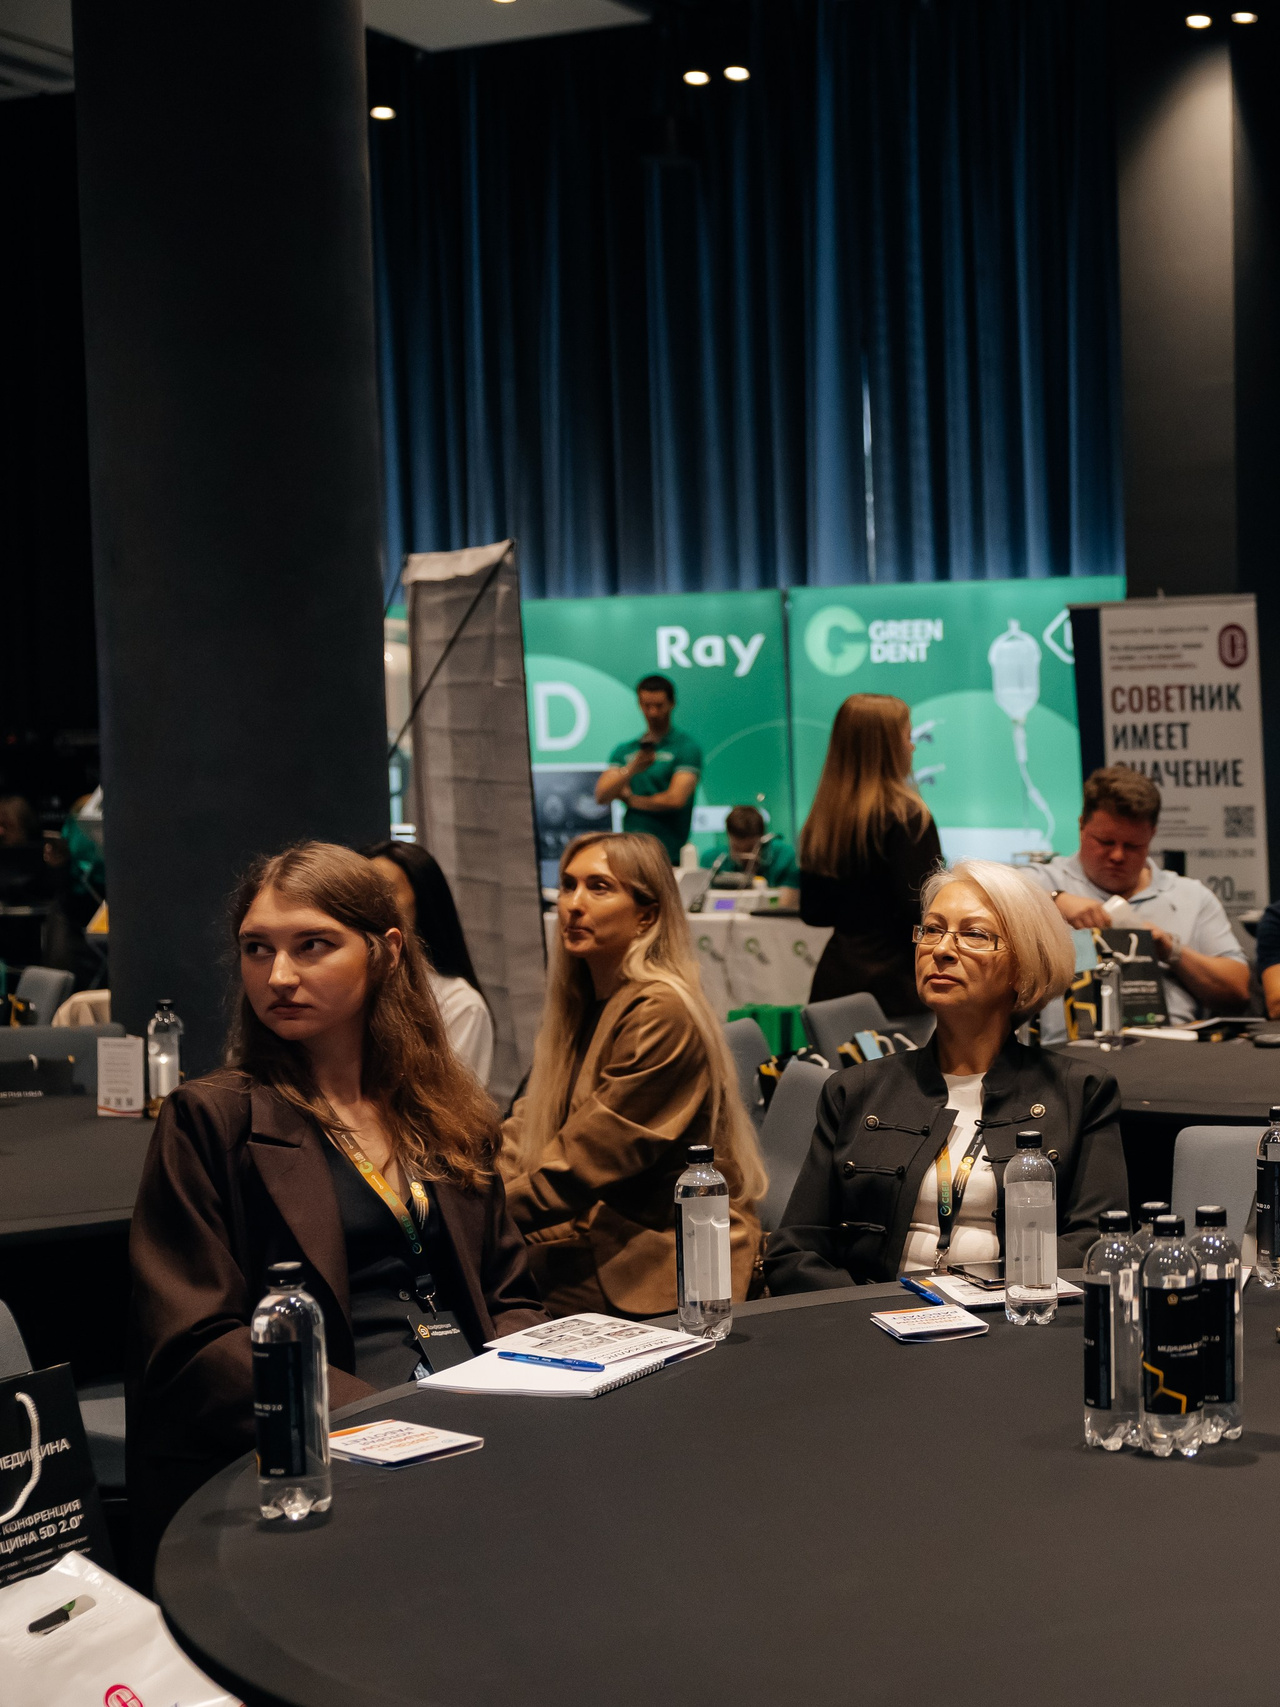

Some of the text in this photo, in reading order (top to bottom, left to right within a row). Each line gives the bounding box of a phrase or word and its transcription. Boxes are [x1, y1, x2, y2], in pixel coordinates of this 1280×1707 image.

[868, 618, 943, 641] GREEN
[656, 625, 765, 677] Ray
[869, 641, 930, 663] DENT
[1111, 683, 1242, 714] СОВЕТНИК
[1112, 722, 1190, 751] ИМЕЕТ
[1115, 759, 1243, 788] АЧЕНИЕ
[0, 1438, 71, 1470] ЕДИИНА
